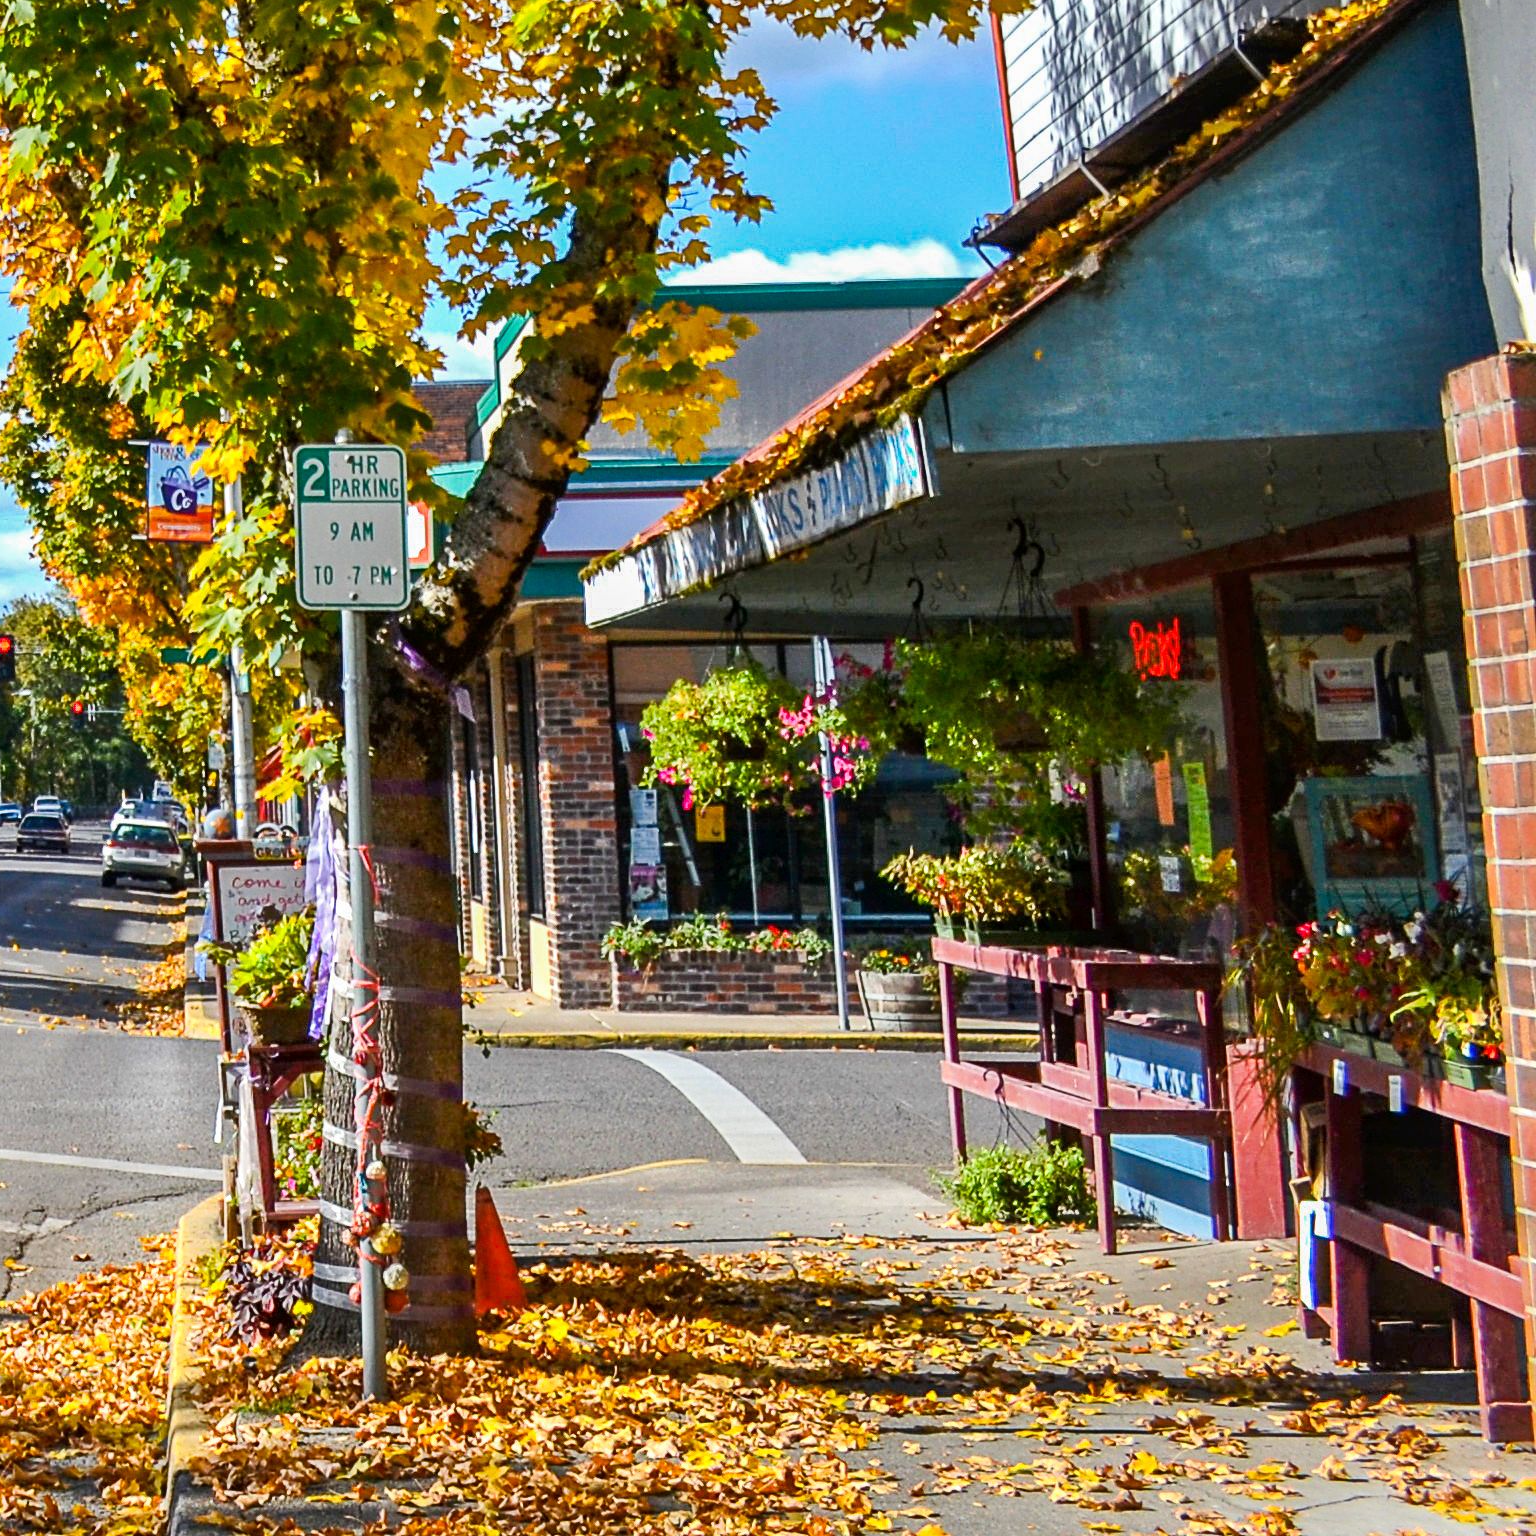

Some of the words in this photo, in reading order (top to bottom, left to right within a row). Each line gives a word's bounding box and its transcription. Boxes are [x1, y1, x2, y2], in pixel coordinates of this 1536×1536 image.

[351, 455, 378, 474] HR
[302, 458, 325, 497] 2
[332, 478, 399, 498] PARKING
[330, 522, 339, 541] 9
[351, 522, 374, 542] AM
[314, 566, 333, 585] TO
[352, 566, 360, 585] 7
[371, 566, 392, 585] PM
[239, 893, 271, 906] and
